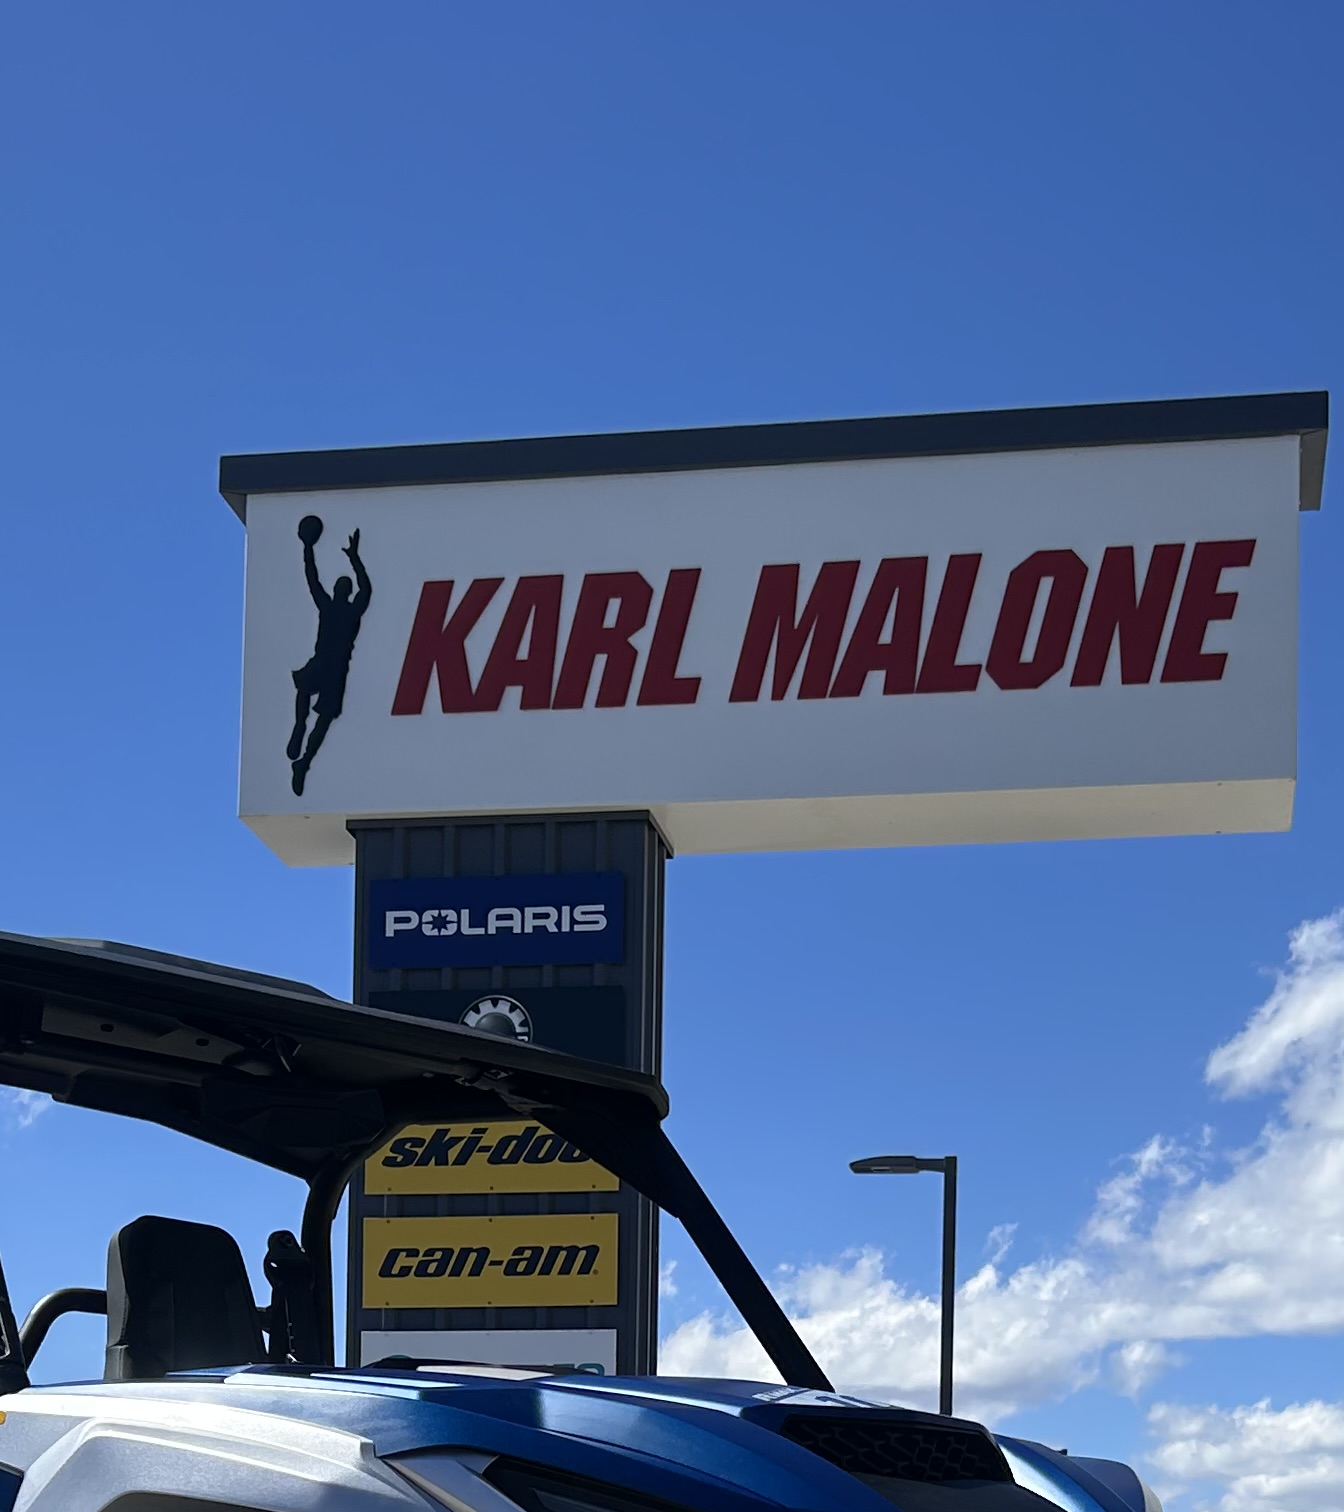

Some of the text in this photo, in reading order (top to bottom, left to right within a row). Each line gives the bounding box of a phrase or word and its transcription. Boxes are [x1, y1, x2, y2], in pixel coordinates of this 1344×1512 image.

[391, 539, 1256, 717] KARL MALONE
[384, 903, 608, 938] POLARIS
[377, 1243, 600, 1279] can-am
